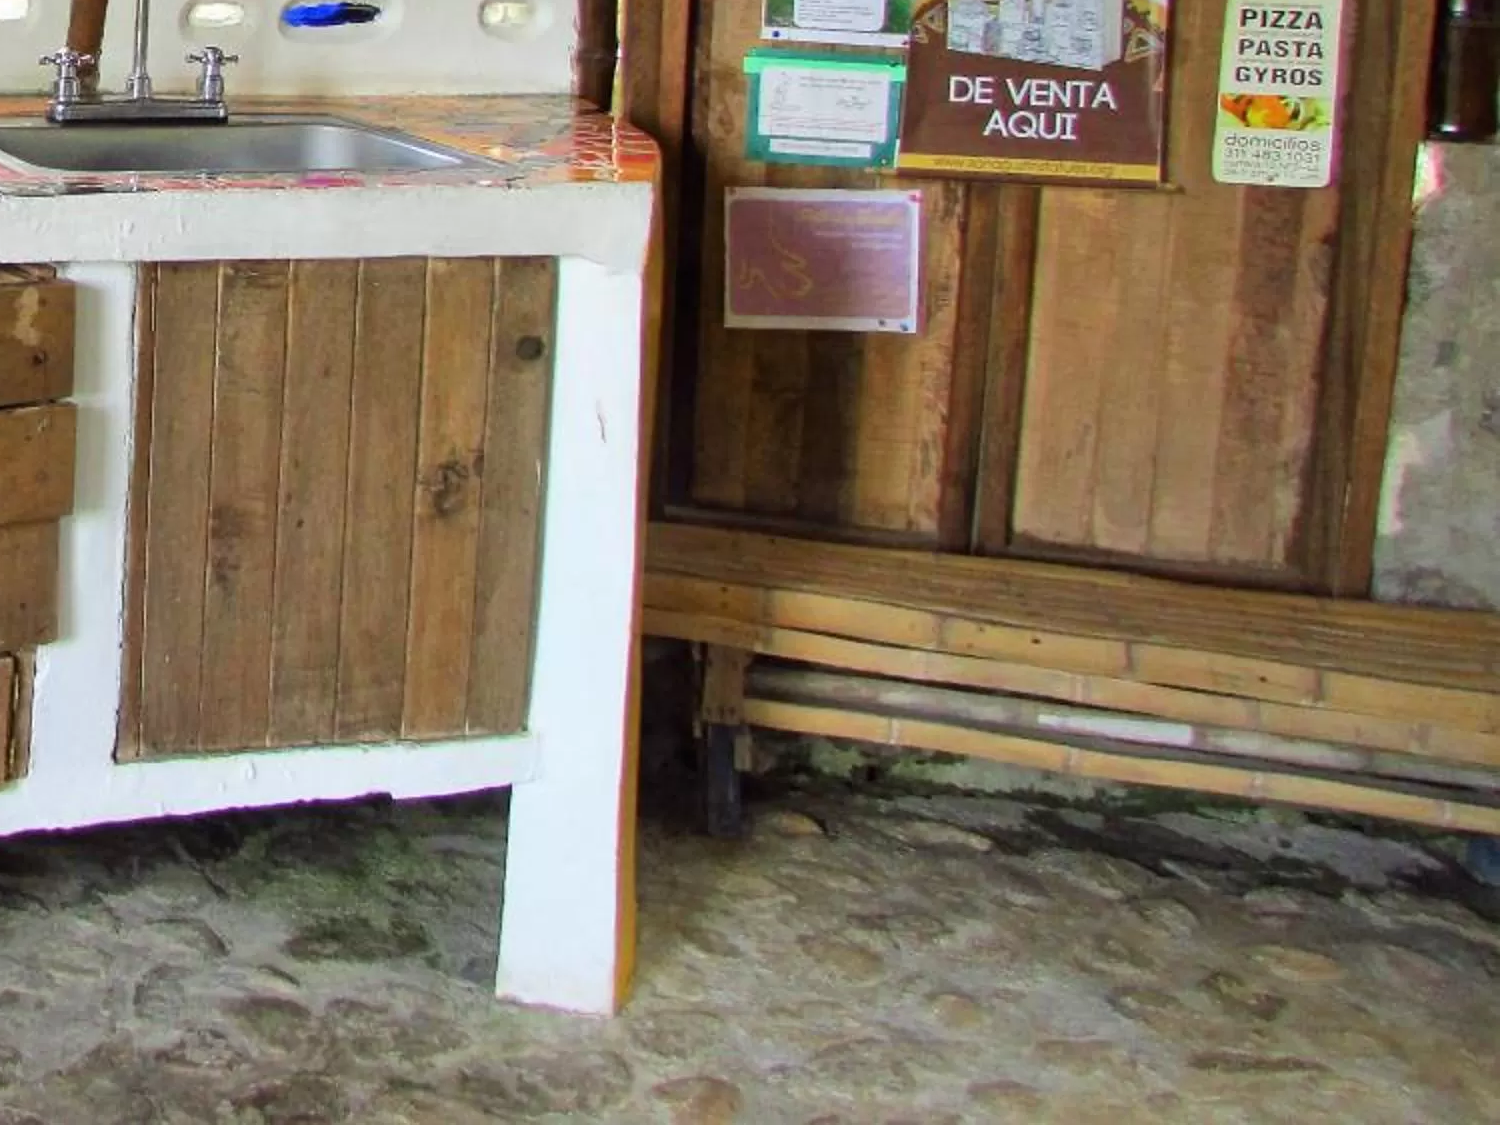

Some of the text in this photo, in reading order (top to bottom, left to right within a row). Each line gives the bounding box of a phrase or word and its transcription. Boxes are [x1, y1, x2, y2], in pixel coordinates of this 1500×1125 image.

[1240, 8, 1323, 30] PIZZA
[1238, 38, 1323, 59] PASTA
[1234, 65, 1323, 86] GYROS
[948, 75, 1118, 110] DE VENTA
[983, 110, 1078, 140] AQUI
[1224, 133, 1321, 151] domicilios
